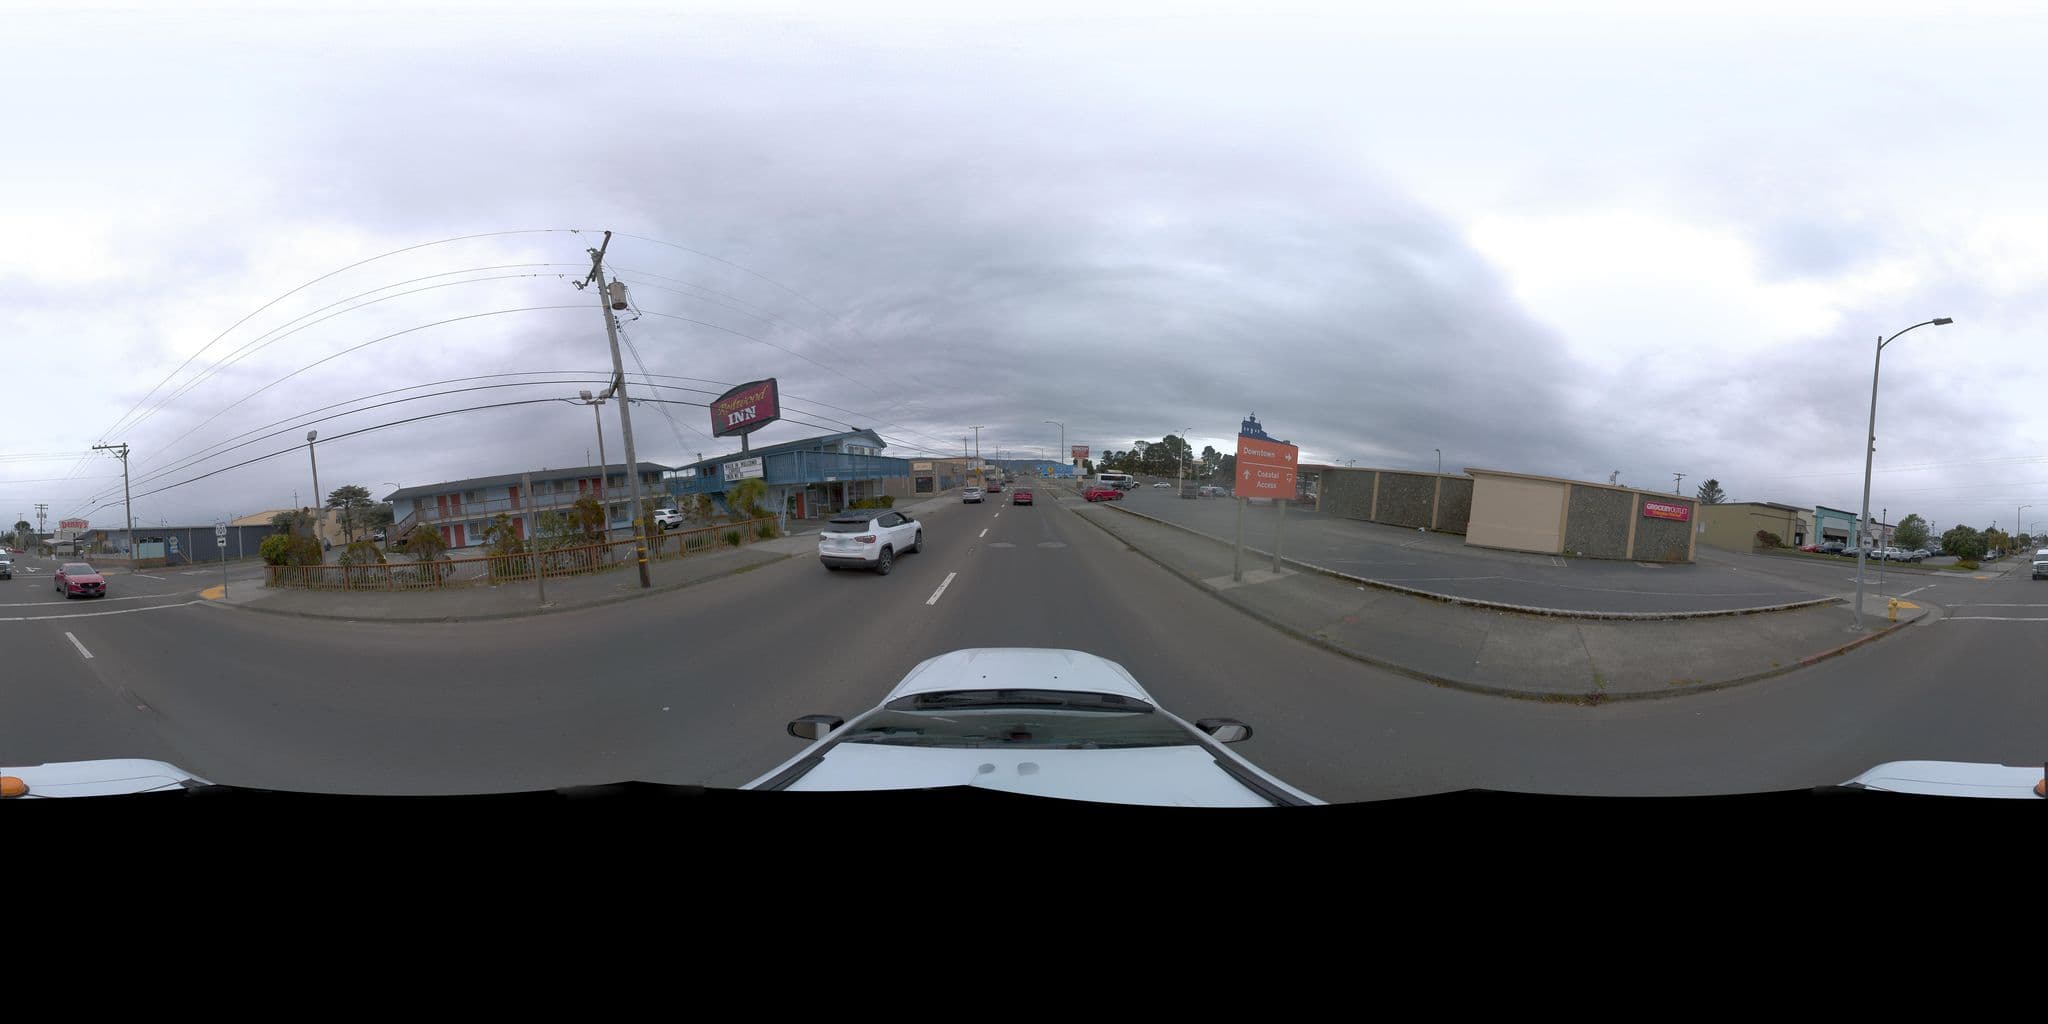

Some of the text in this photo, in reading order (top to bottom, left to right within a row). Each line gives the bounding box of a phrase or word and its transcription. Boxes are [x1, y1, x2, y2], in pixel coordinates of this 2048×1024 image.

[728, 405, 757, 426] INN
[1243, 447, 1276, 458] Downtown
[1257, 470, 1280, 479] Coastal
[1256, 481, 1277, 489] Access
